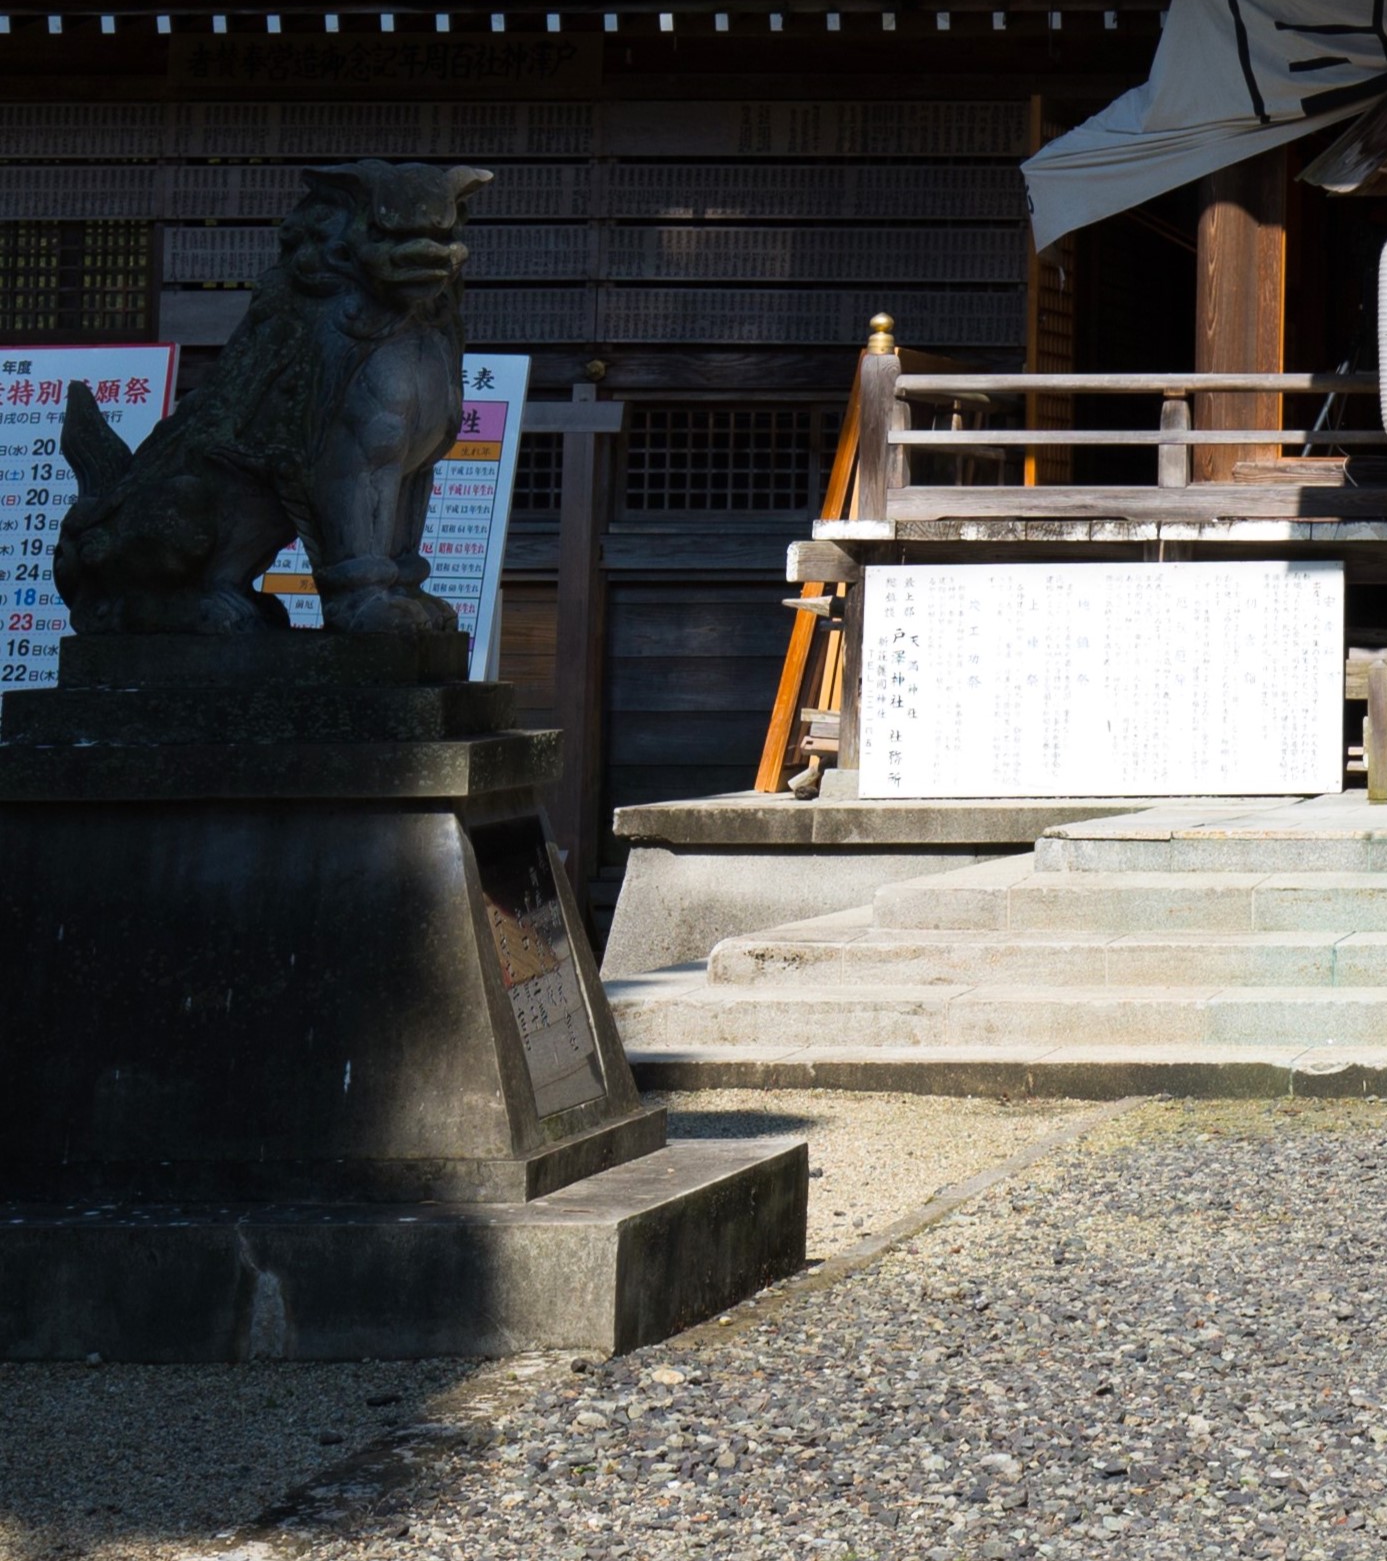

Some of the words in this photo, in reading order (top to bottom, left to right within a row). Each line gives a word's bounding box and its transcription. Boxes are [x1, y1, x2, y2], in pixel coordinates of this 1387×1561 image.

[2, 360, 32, 375] 年度
[0, 377, 151, 406] 特別願祭
[0, 410, 41, 424] 戌の日
